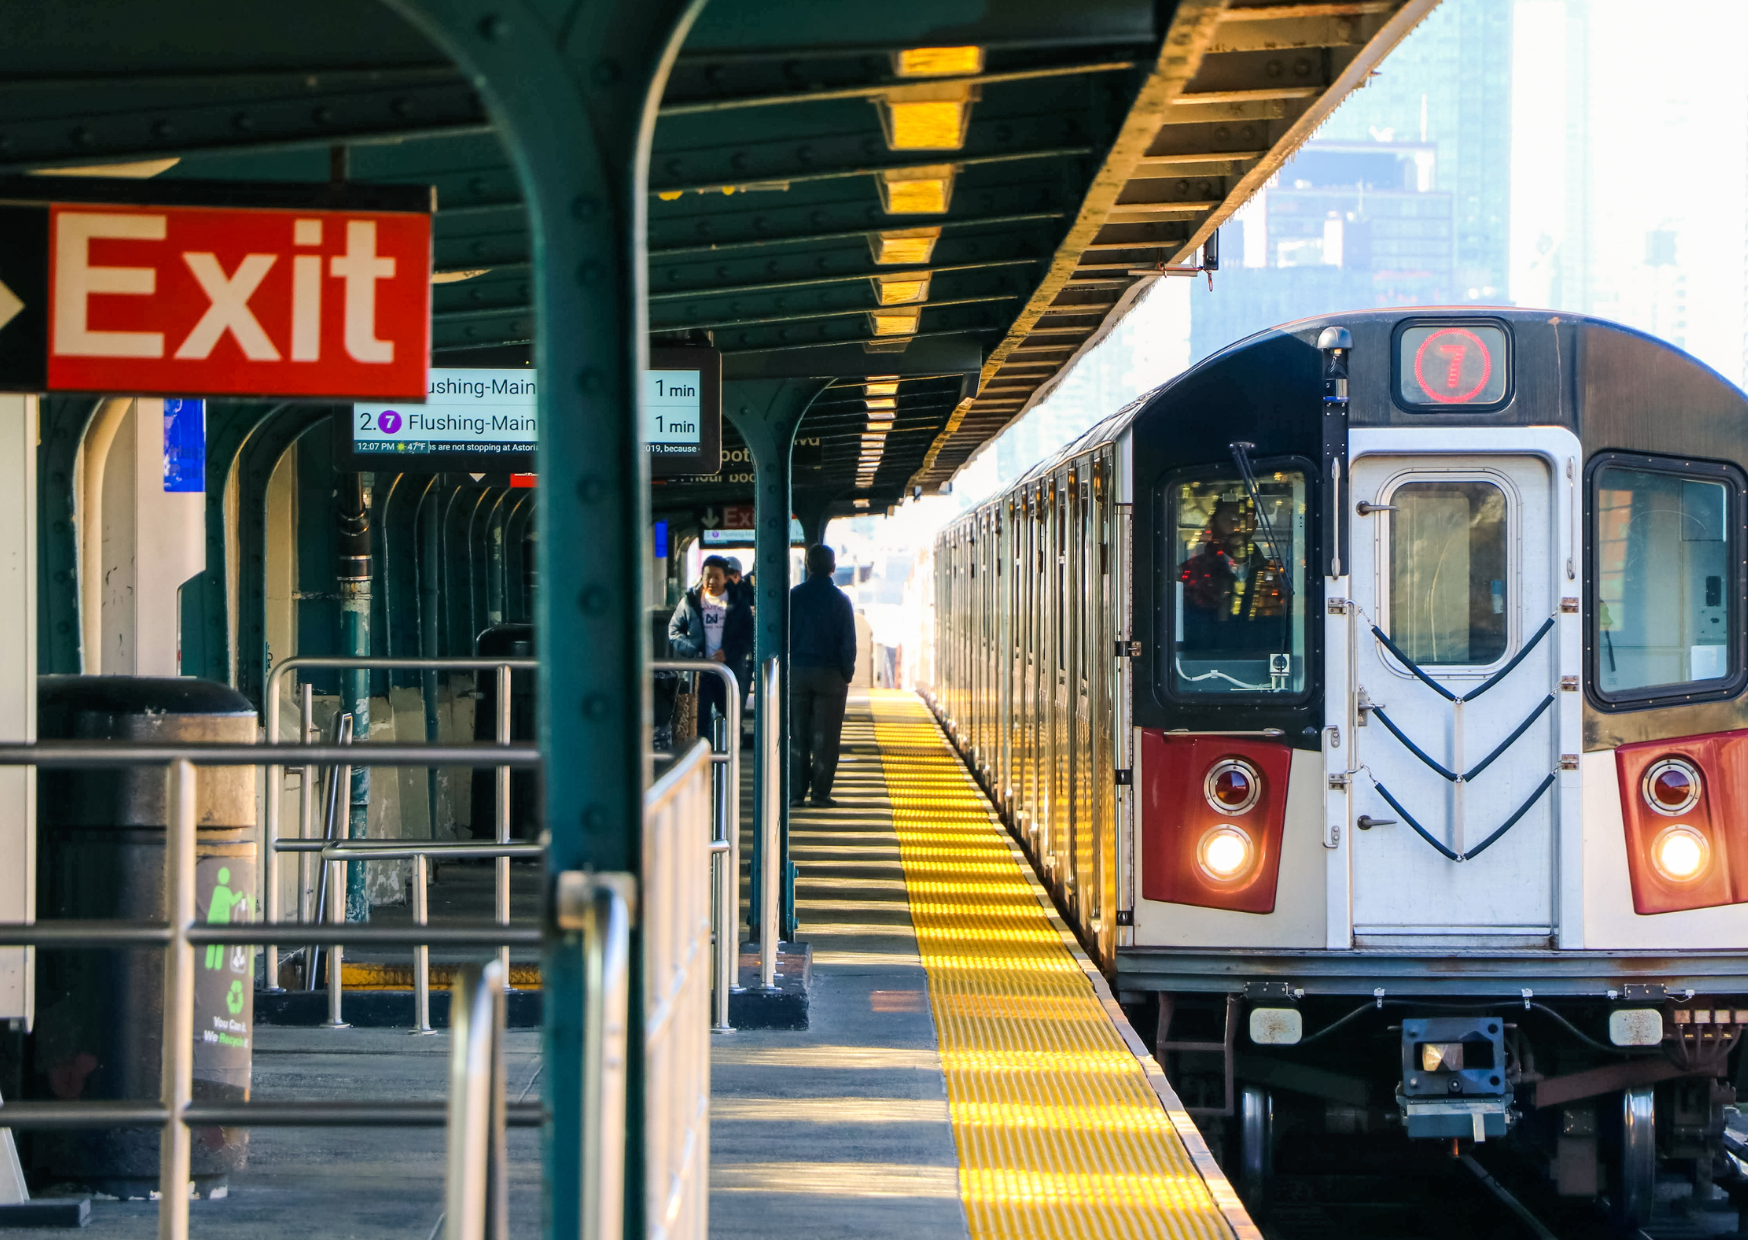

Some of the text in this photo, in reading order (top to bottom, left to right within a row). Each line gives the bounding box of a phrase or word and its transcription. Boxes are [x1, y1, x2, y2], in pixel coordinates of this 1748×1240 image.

[53, 212, 396, 364] Exit
[1440, 345, 1466, 388] 7
[428, 378, 695, 398] ushing-Main 1 min
[360, 413, 695, 434] 2. 7 Flushing-Main 1 min
[357, 442, 380, 451] 12:07
[381, 442, 395, 451] PM
[452, 443, 465, 451] not
[467, 443, 501, 453] stopping
[503, 443, 511, 451] at
[643, 444, 663, 453] 019,
[664, 443, 697, 452] because
[722, 448, 750, 462] oot
[724, 507, 755, 527] Exi
[213, 1016, 228, 1029] You
[204, 1030, 218, 1042] We
